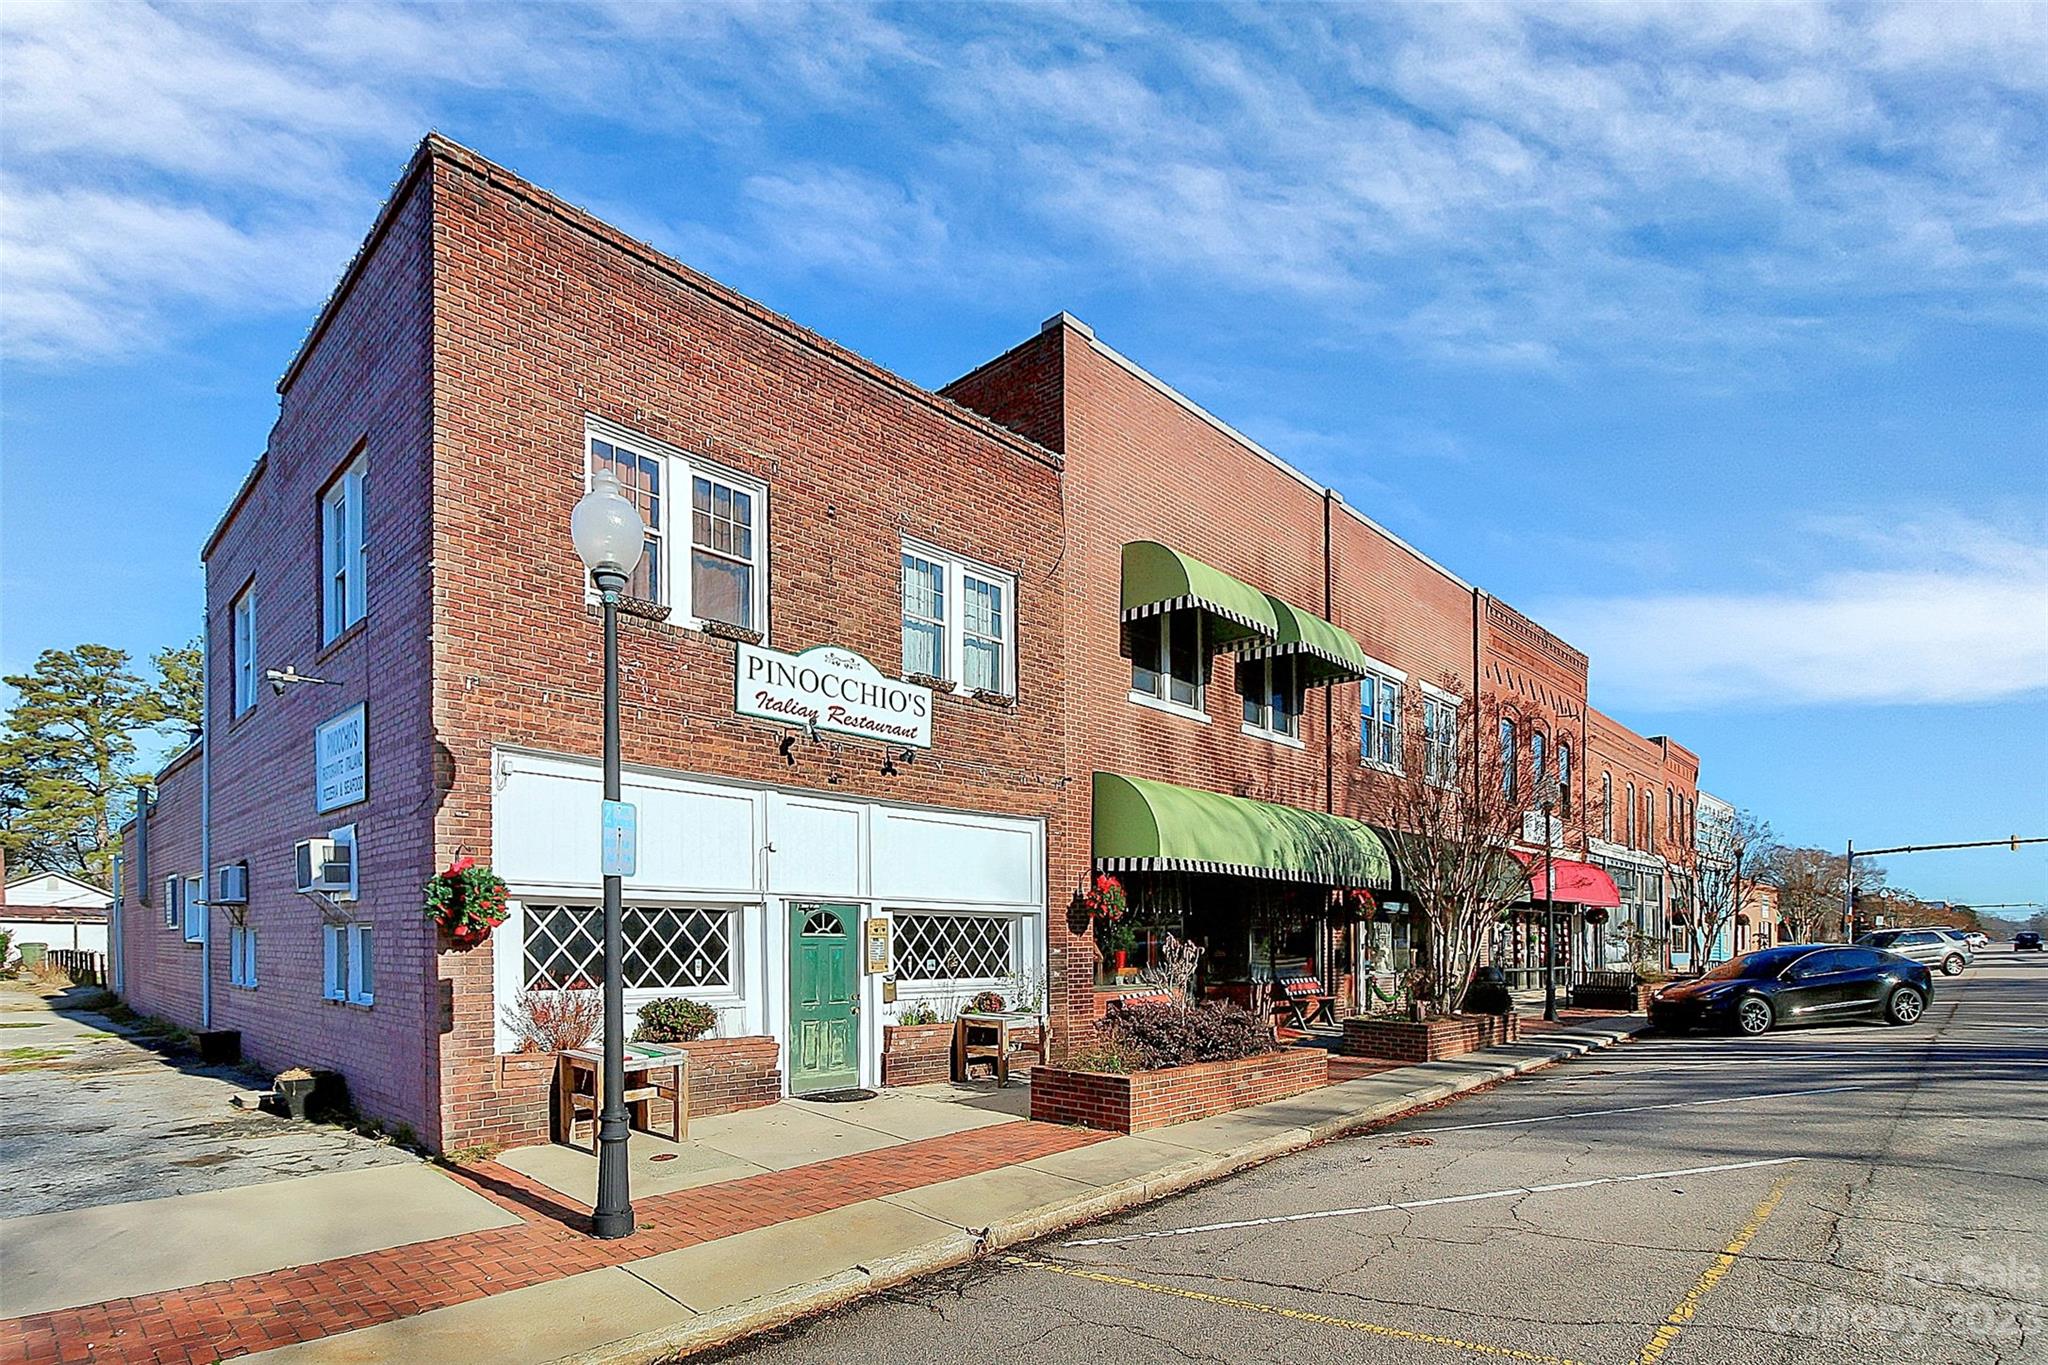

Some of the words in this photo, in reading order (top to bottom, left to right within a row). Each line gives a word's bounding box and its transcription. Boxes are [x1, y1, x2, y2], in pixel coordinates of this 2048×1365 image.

[747, 654, 926, 718] PINOCCHIO'S
[755, 690, 820, 721] Italian
[827, 705, 919, 740] Restaurant
